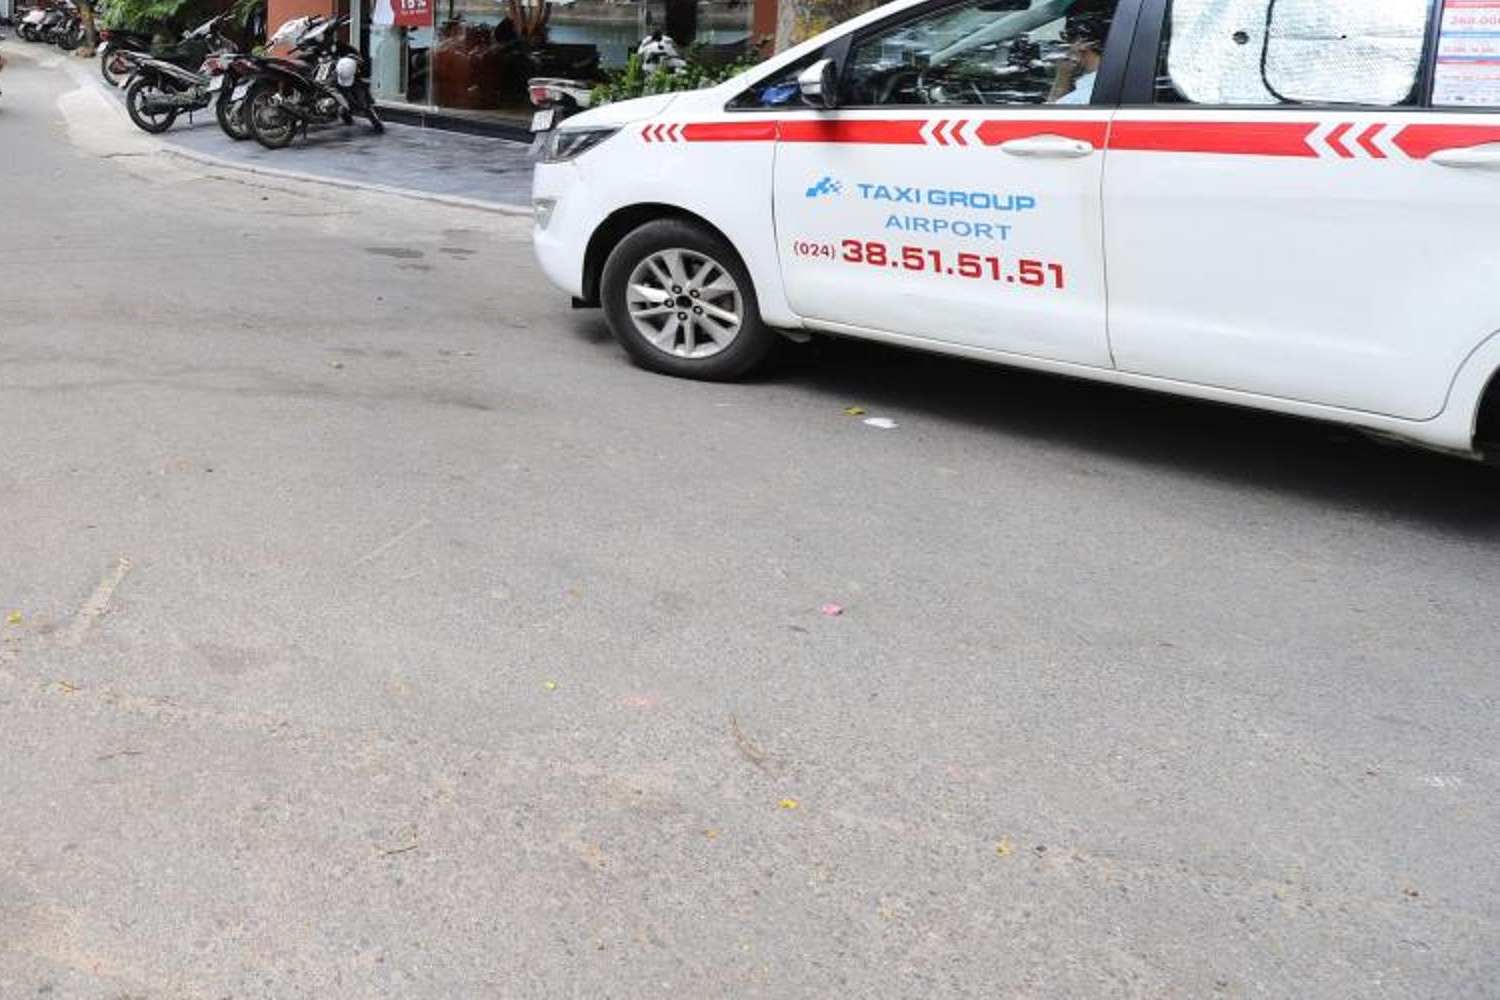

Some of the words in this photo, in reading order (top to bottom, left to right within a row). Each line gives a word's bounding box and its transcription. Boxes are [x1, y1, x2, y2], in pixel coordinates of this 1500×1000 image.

[857, 183, 921, 203] TAXI
[927, 189, 1036, 212] GROUP
[884, 214, 1013, 241] AIRPORT
[793, 241, 836, 260] (024)
[841, 239, 1065, 290] 38.51.51.51
